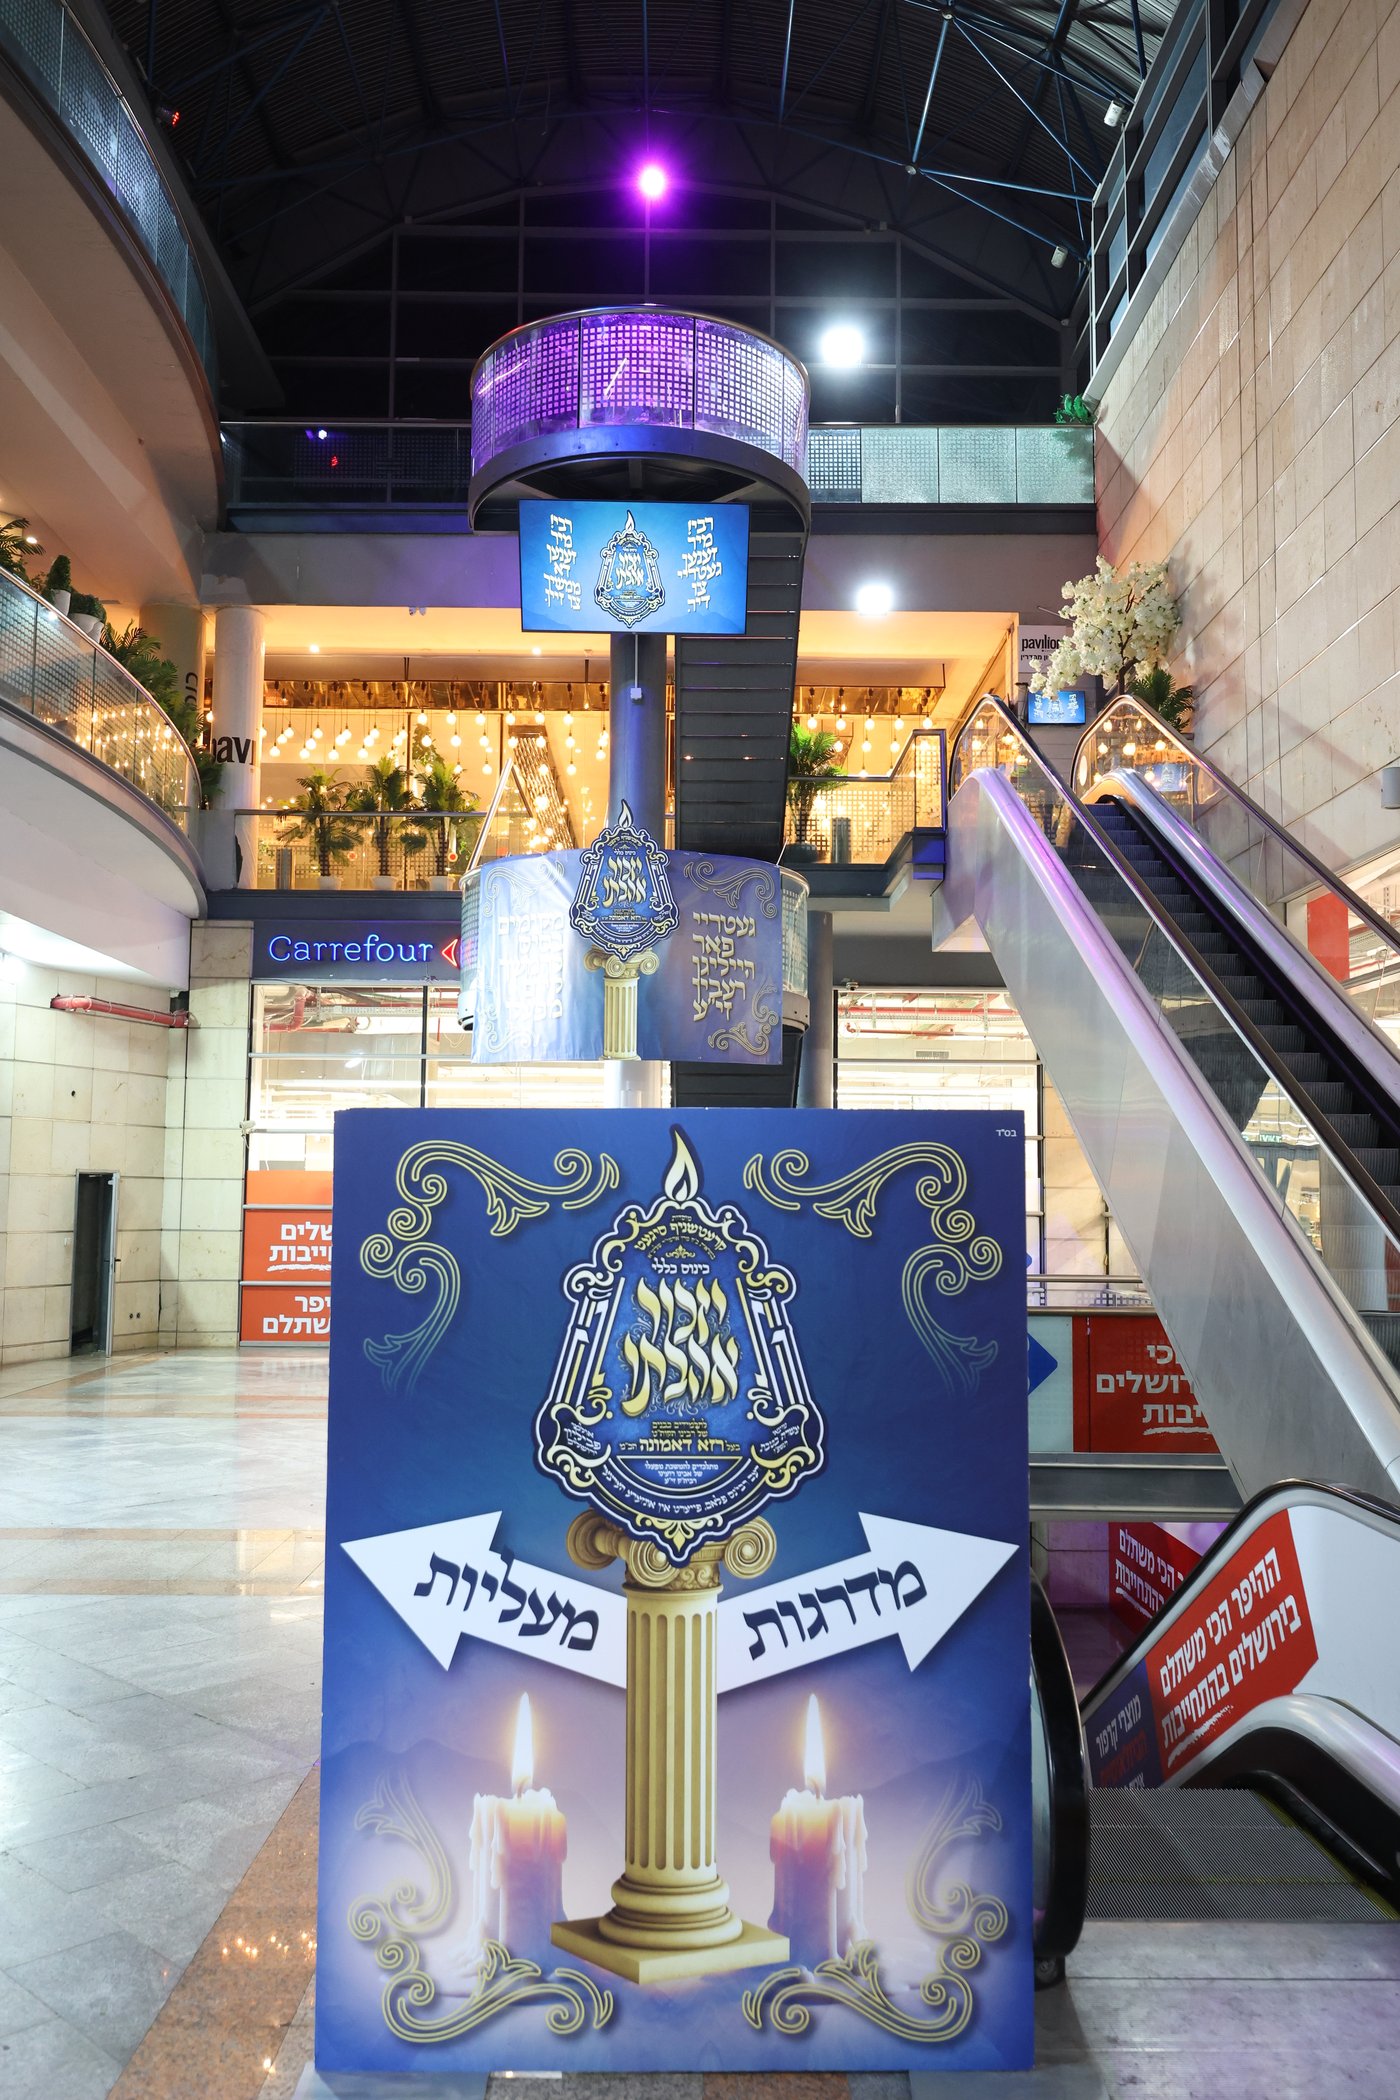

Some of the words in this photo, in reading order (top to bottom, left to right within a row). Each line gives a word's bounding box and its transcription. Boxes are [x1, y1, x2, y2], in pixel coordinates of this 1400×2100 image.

[692, 911, 756, 937] געטריי
[268, 934, 434, 962] Carrefour
[692, 933, 735, 958] פאר
[692, 952, 756, 982] הייליגן
[692, 977, 746, 1003] רעבין
[995, 1128, 1017, 1137] בס"ד
[281, 1221, 332, 1241] שלים
[634, 1225, 667, 1251] סיגעט
[670, 1221, 727, 1251] קרעטשניף
[269, 1245, 331, 1262] ייבות
[651, 1256, 678, 1275] כללי
[680, 1263, 710, 1275] כינוס
[295, 1296, 331, 1313] יפר
[262, 1314, 330, 1334] שתלם
[1096, 1370, 1195, 1394] רושלים
[1142, 1404, 1203, 1424] יבות
[563, 1427, 601, 1451] פביליון
[639, 1438, 693, 1452] דאמונה
[697, 1438, 725, 1452] רזא
[1119, 1528, 1155, 1575] משתלם
[1157, 1556, 1175, 1591] הכי
[1231, 1547, 1281, 1620] ההיפר
[413, 1544, 600, 1651] מעליות
[742, 1559, 928, 1661] מדרגות
[1205, 1599, 1233, 1646] הכי
[1228, 1594, 1302, 1687] בירושלים
[1159, 1627, 1207, 1698] משתלם
[1117, 1694, 1142, 1733] מוצרי
[1161, 1662, 1230, 1749] בהתחייבות
[1095, 1718, 1119, 1759] קרפור
